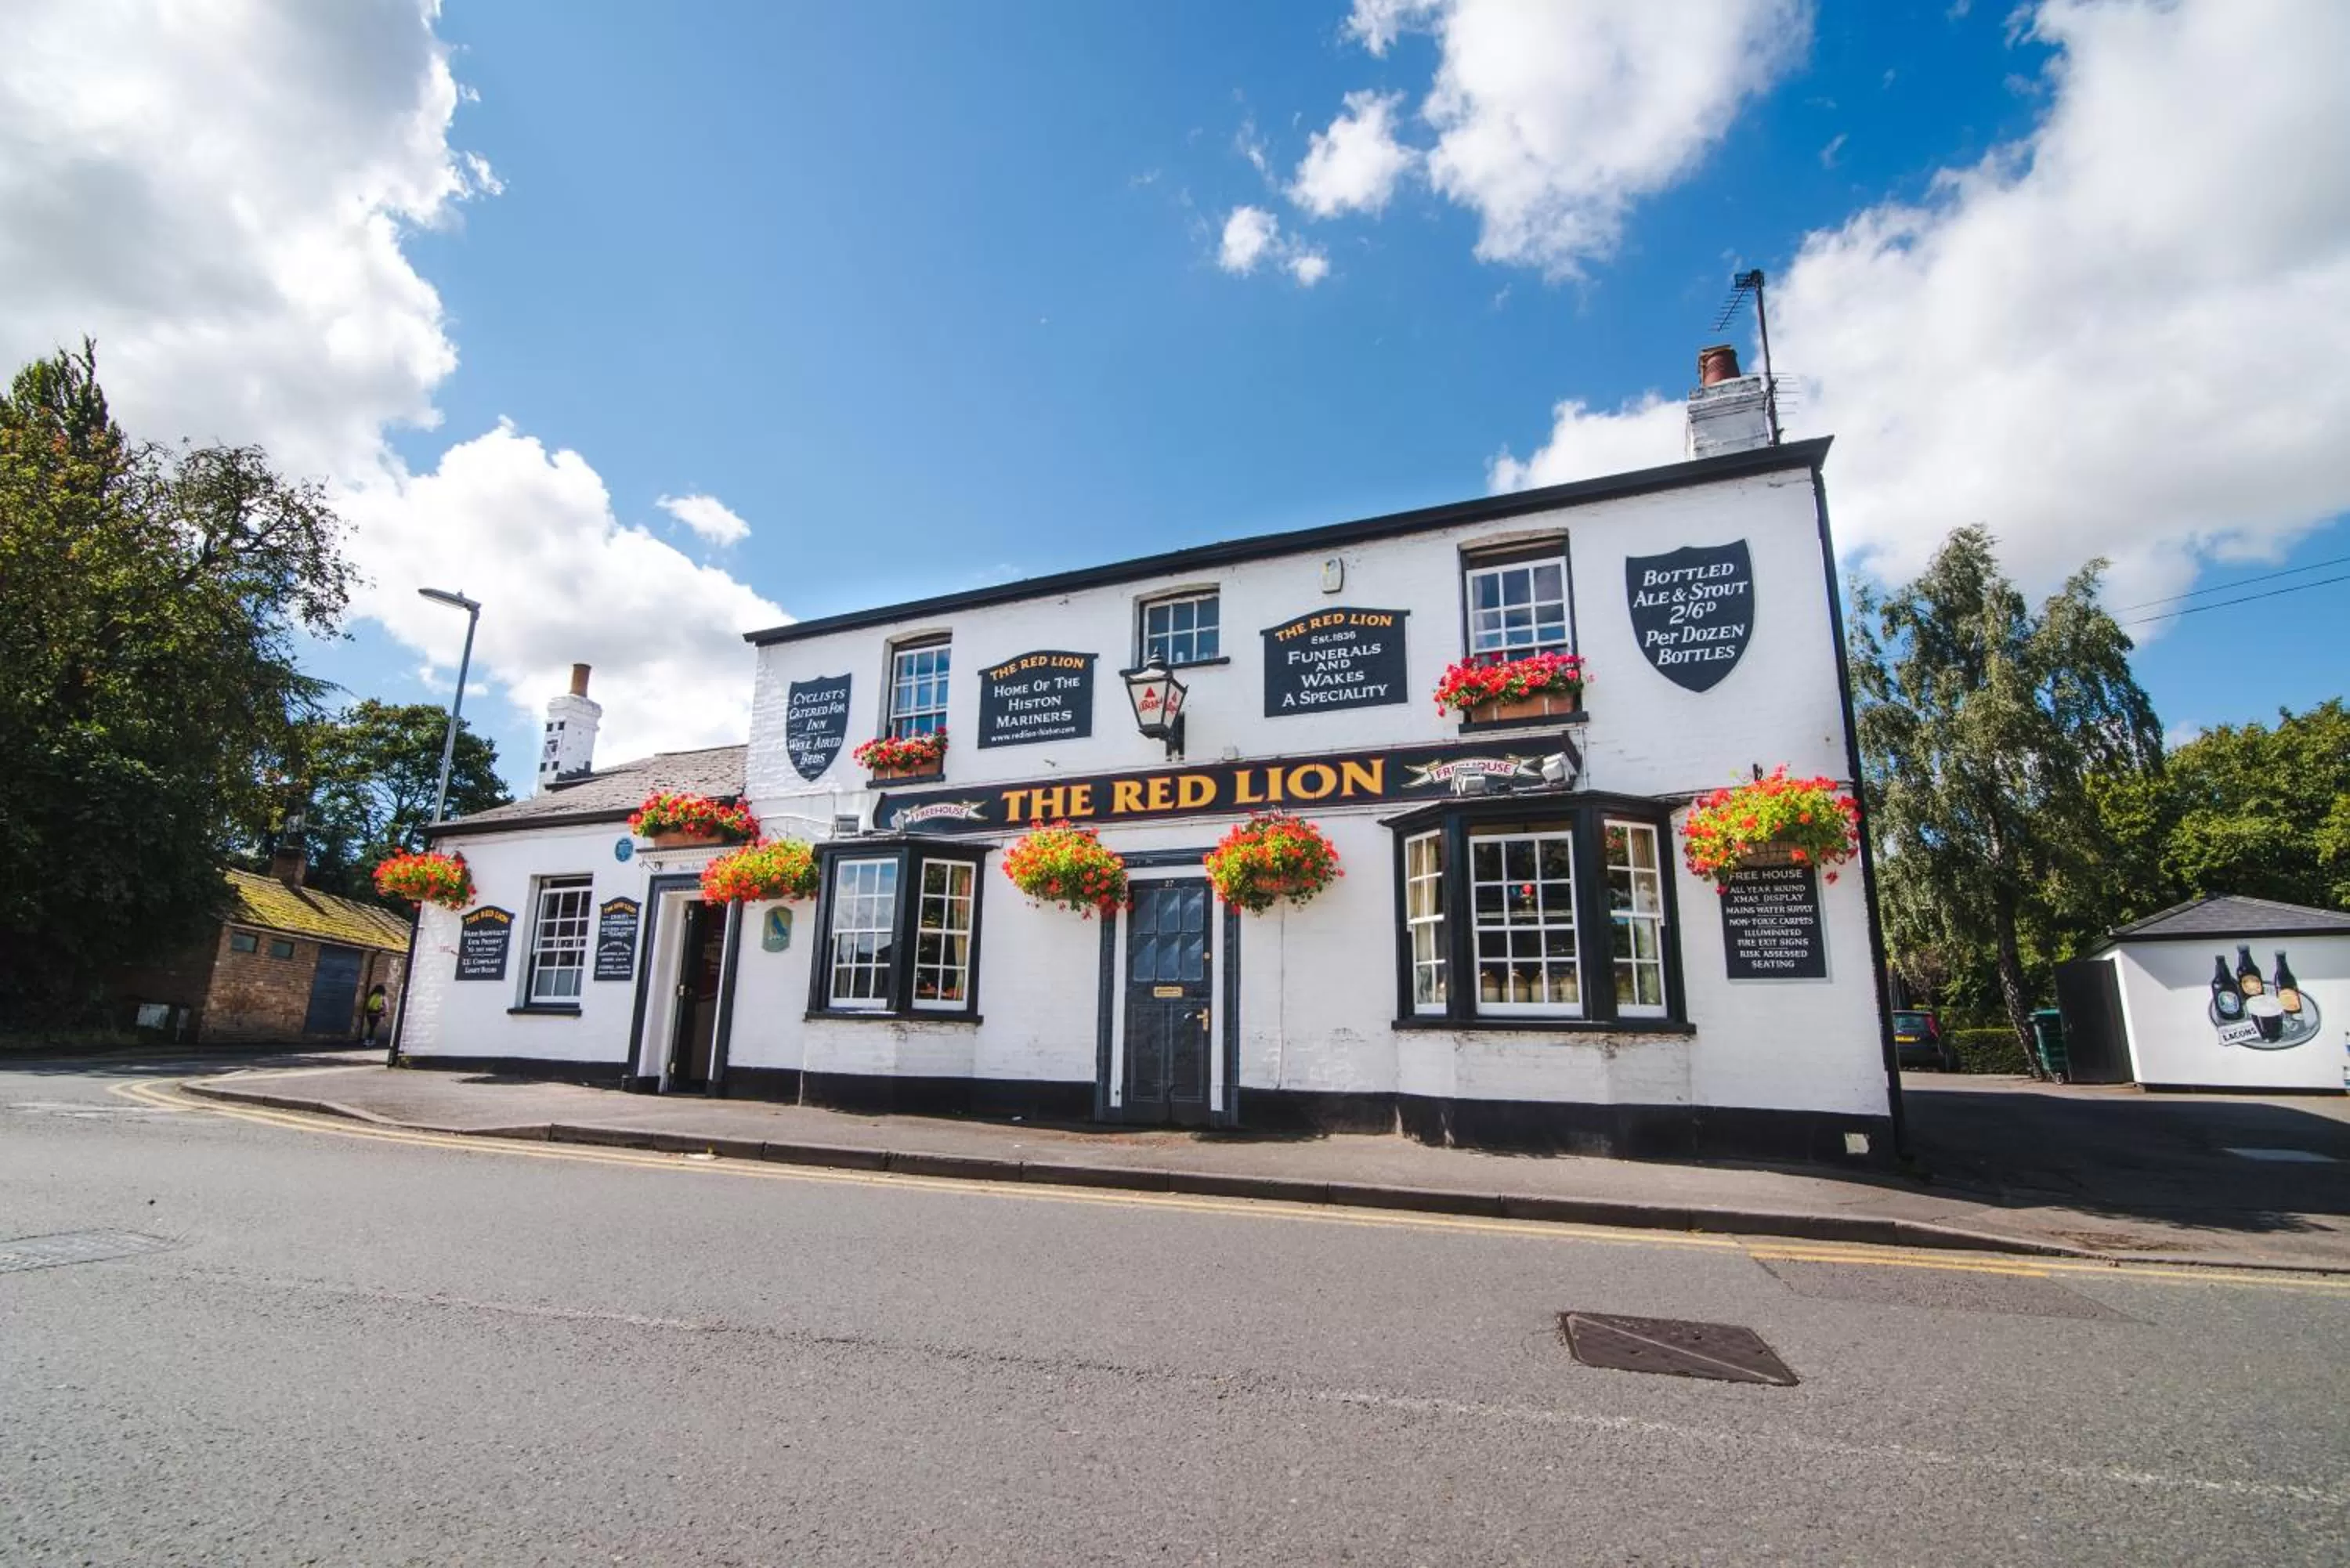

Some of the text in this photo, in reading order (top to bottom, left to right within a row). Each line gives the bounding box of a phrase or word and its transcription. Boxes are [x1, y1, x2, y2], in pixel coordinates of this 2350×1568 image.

[1643, 563, 1734, 586] BOTTLED
[1633, 581, 1748, 608] ALE & STOUT
[1275, 613, 1393, 642] THE RED LION
[1682, 623, 1745, 643] DOZEN
[1288, 643, 1381, 664] FUNERALS
[1658, 645, 1736, 666] BOTTLES
[990, 656, 1085, 681] THE RED LION
[1316, 659, 1351, 672] AND
[994, 676, 1080, 698] HOME OF THE
[1300, 670, 1365, 688] WAKES
[794, 688, 846, 705] CYCLISTS
[1008, 695, 1061, 711] HISTON
[1282, 684, 1389, 706] A SPECIALITY
[790, 702, 845, 720] CATERED FOR
[996, 710, 1072, 729] MARINERS
[806, 718, 827, 730] INN
[789, 736, 842, 750] WELL AIRED
[800, 752, 826, 765] BEDS
[1002, 759, 1384, 822] THE RED LION
[1729, 869, 1803, 881] FREE HOUSE
[1746, 885, 1770, 894] YEAR
[1726, 906, 1755, 915] MAINS
[1744, 928, 1802, 937] ILLUMINATED
[1779, 938, 1809, 946] SIGNS
[1763, 949, 1807, 958] ASSESSED
[1752, 959, 1795, 970] SEATING
[2222, 1027, 2257, 1042] LACONS
